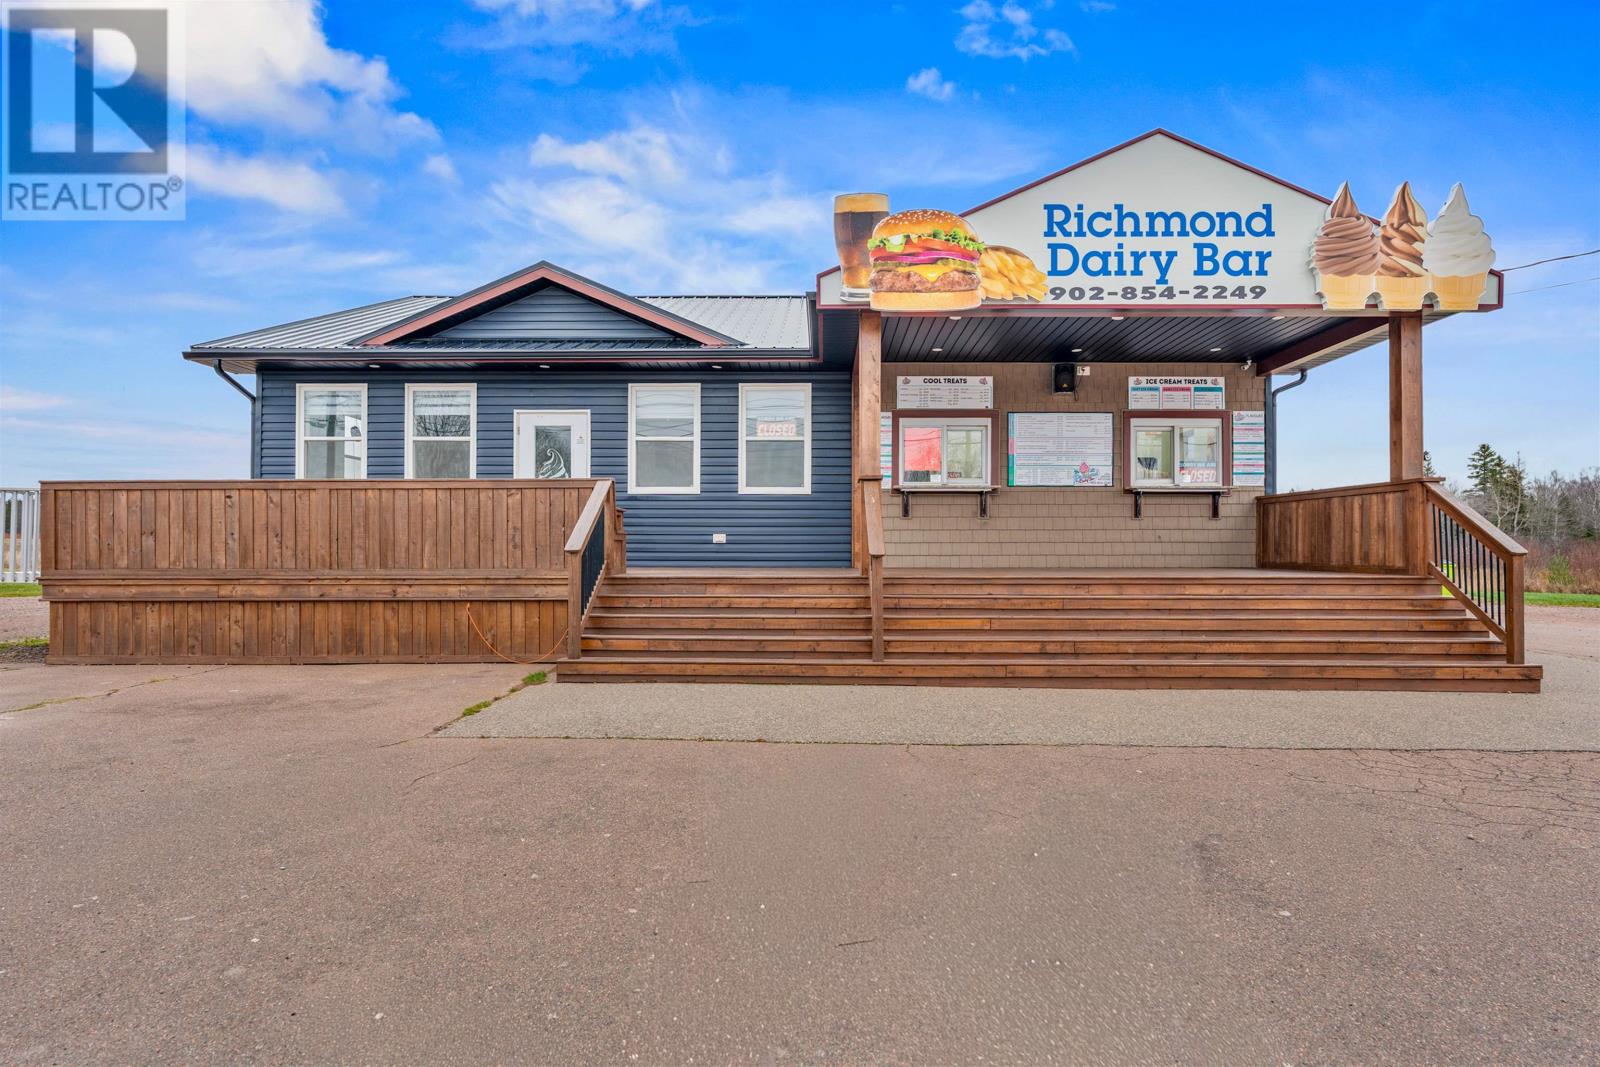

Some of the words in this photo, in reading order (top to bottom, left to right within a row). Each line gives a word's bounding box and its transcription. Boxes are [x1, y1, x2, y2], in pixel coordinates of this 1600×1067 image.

[1043, 203, 1276, 238] Richmond
[1047, 242, 1178, 285] Dairy
[1193, 242, 1273, 277] Bar
[1049, 285, 1268, 301] 902-854-2249
[757, 422, 797, 437] CLOSED
[1180, 469, 1217, 482] OSED
